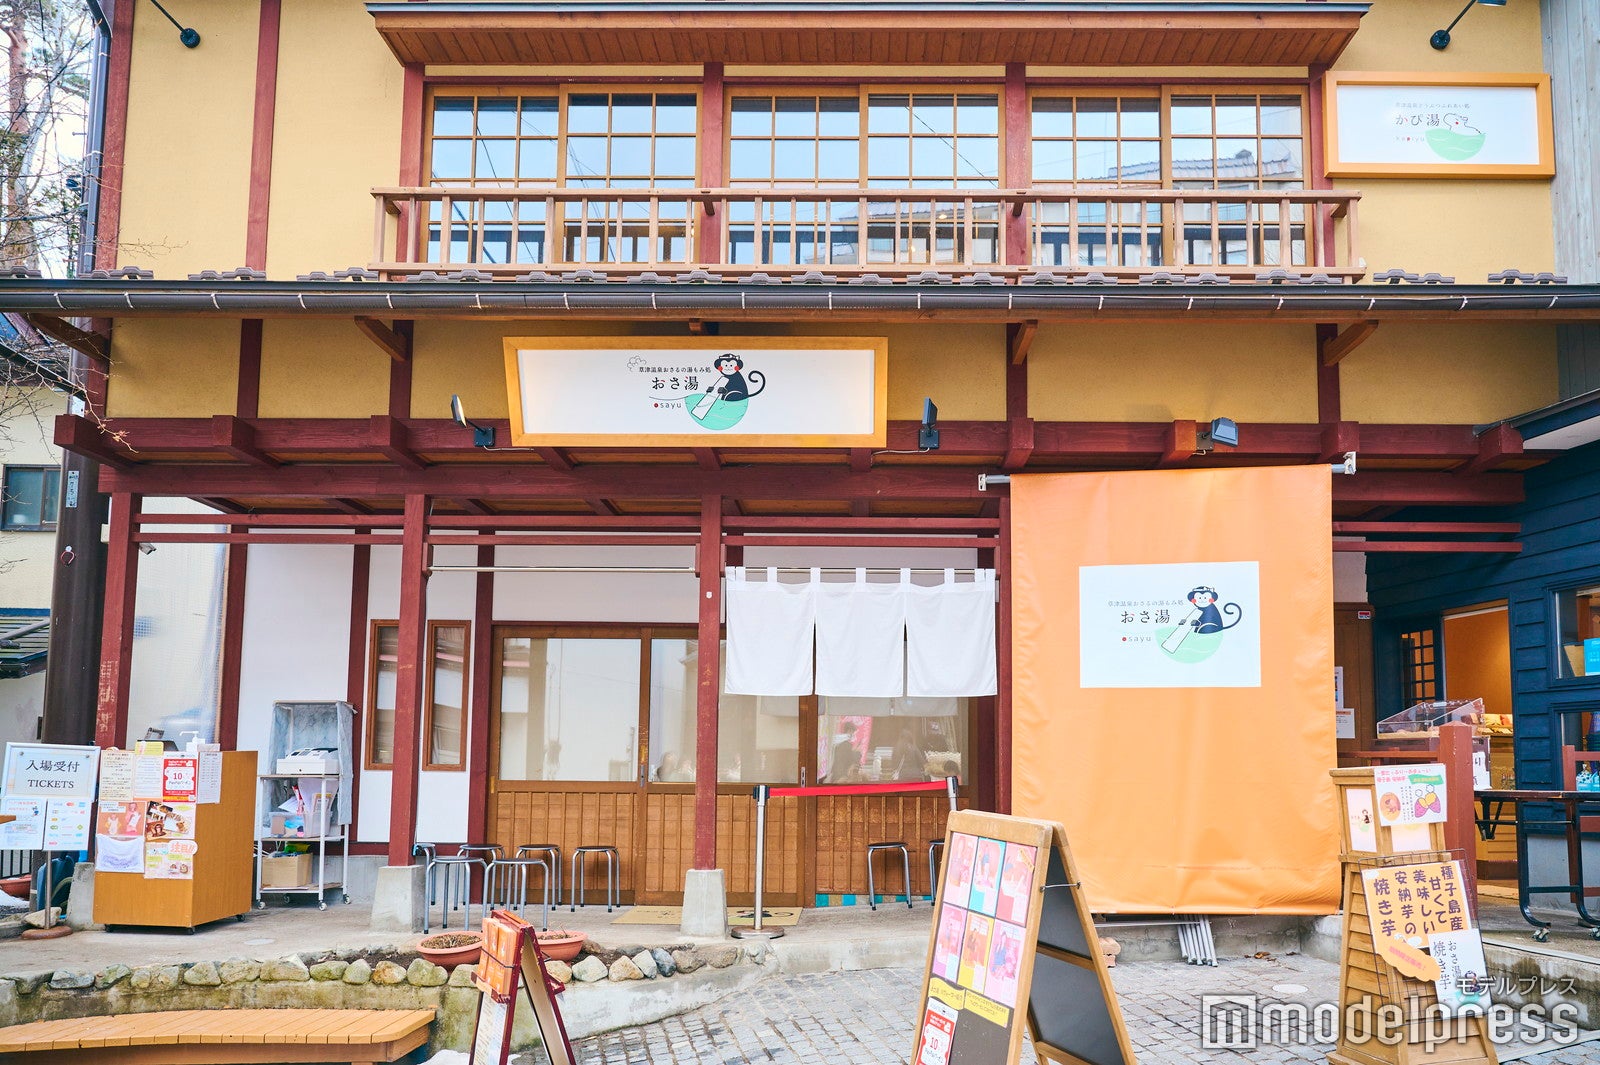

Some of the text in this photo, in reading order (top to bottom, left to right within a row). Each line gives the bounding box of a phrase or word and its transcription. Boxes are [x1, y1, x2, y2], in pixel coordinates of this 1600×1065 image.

[1395, 113, 1440, 126] かぴ湯
[651, 375, 699, 391] おさ湯
[1120, 609, 1170, 624] おさ湯
[26, 759, 80, 773] 入場受付
[27, 779, 75, 789] TICKETS
[1373, 878, 1397, 937] 焼き芋
[1394, 870, 1416, 935] 安納芋の
[1413, 869, 1436, 934] 美味しい
[1429, 876, 1447, 924] 甘くて
[1440, 865, 1463, 931] 種子島産
[1433, 940, 1451, 990] 焼き芋
[1448, 940, 1462, 978] おさ湯
